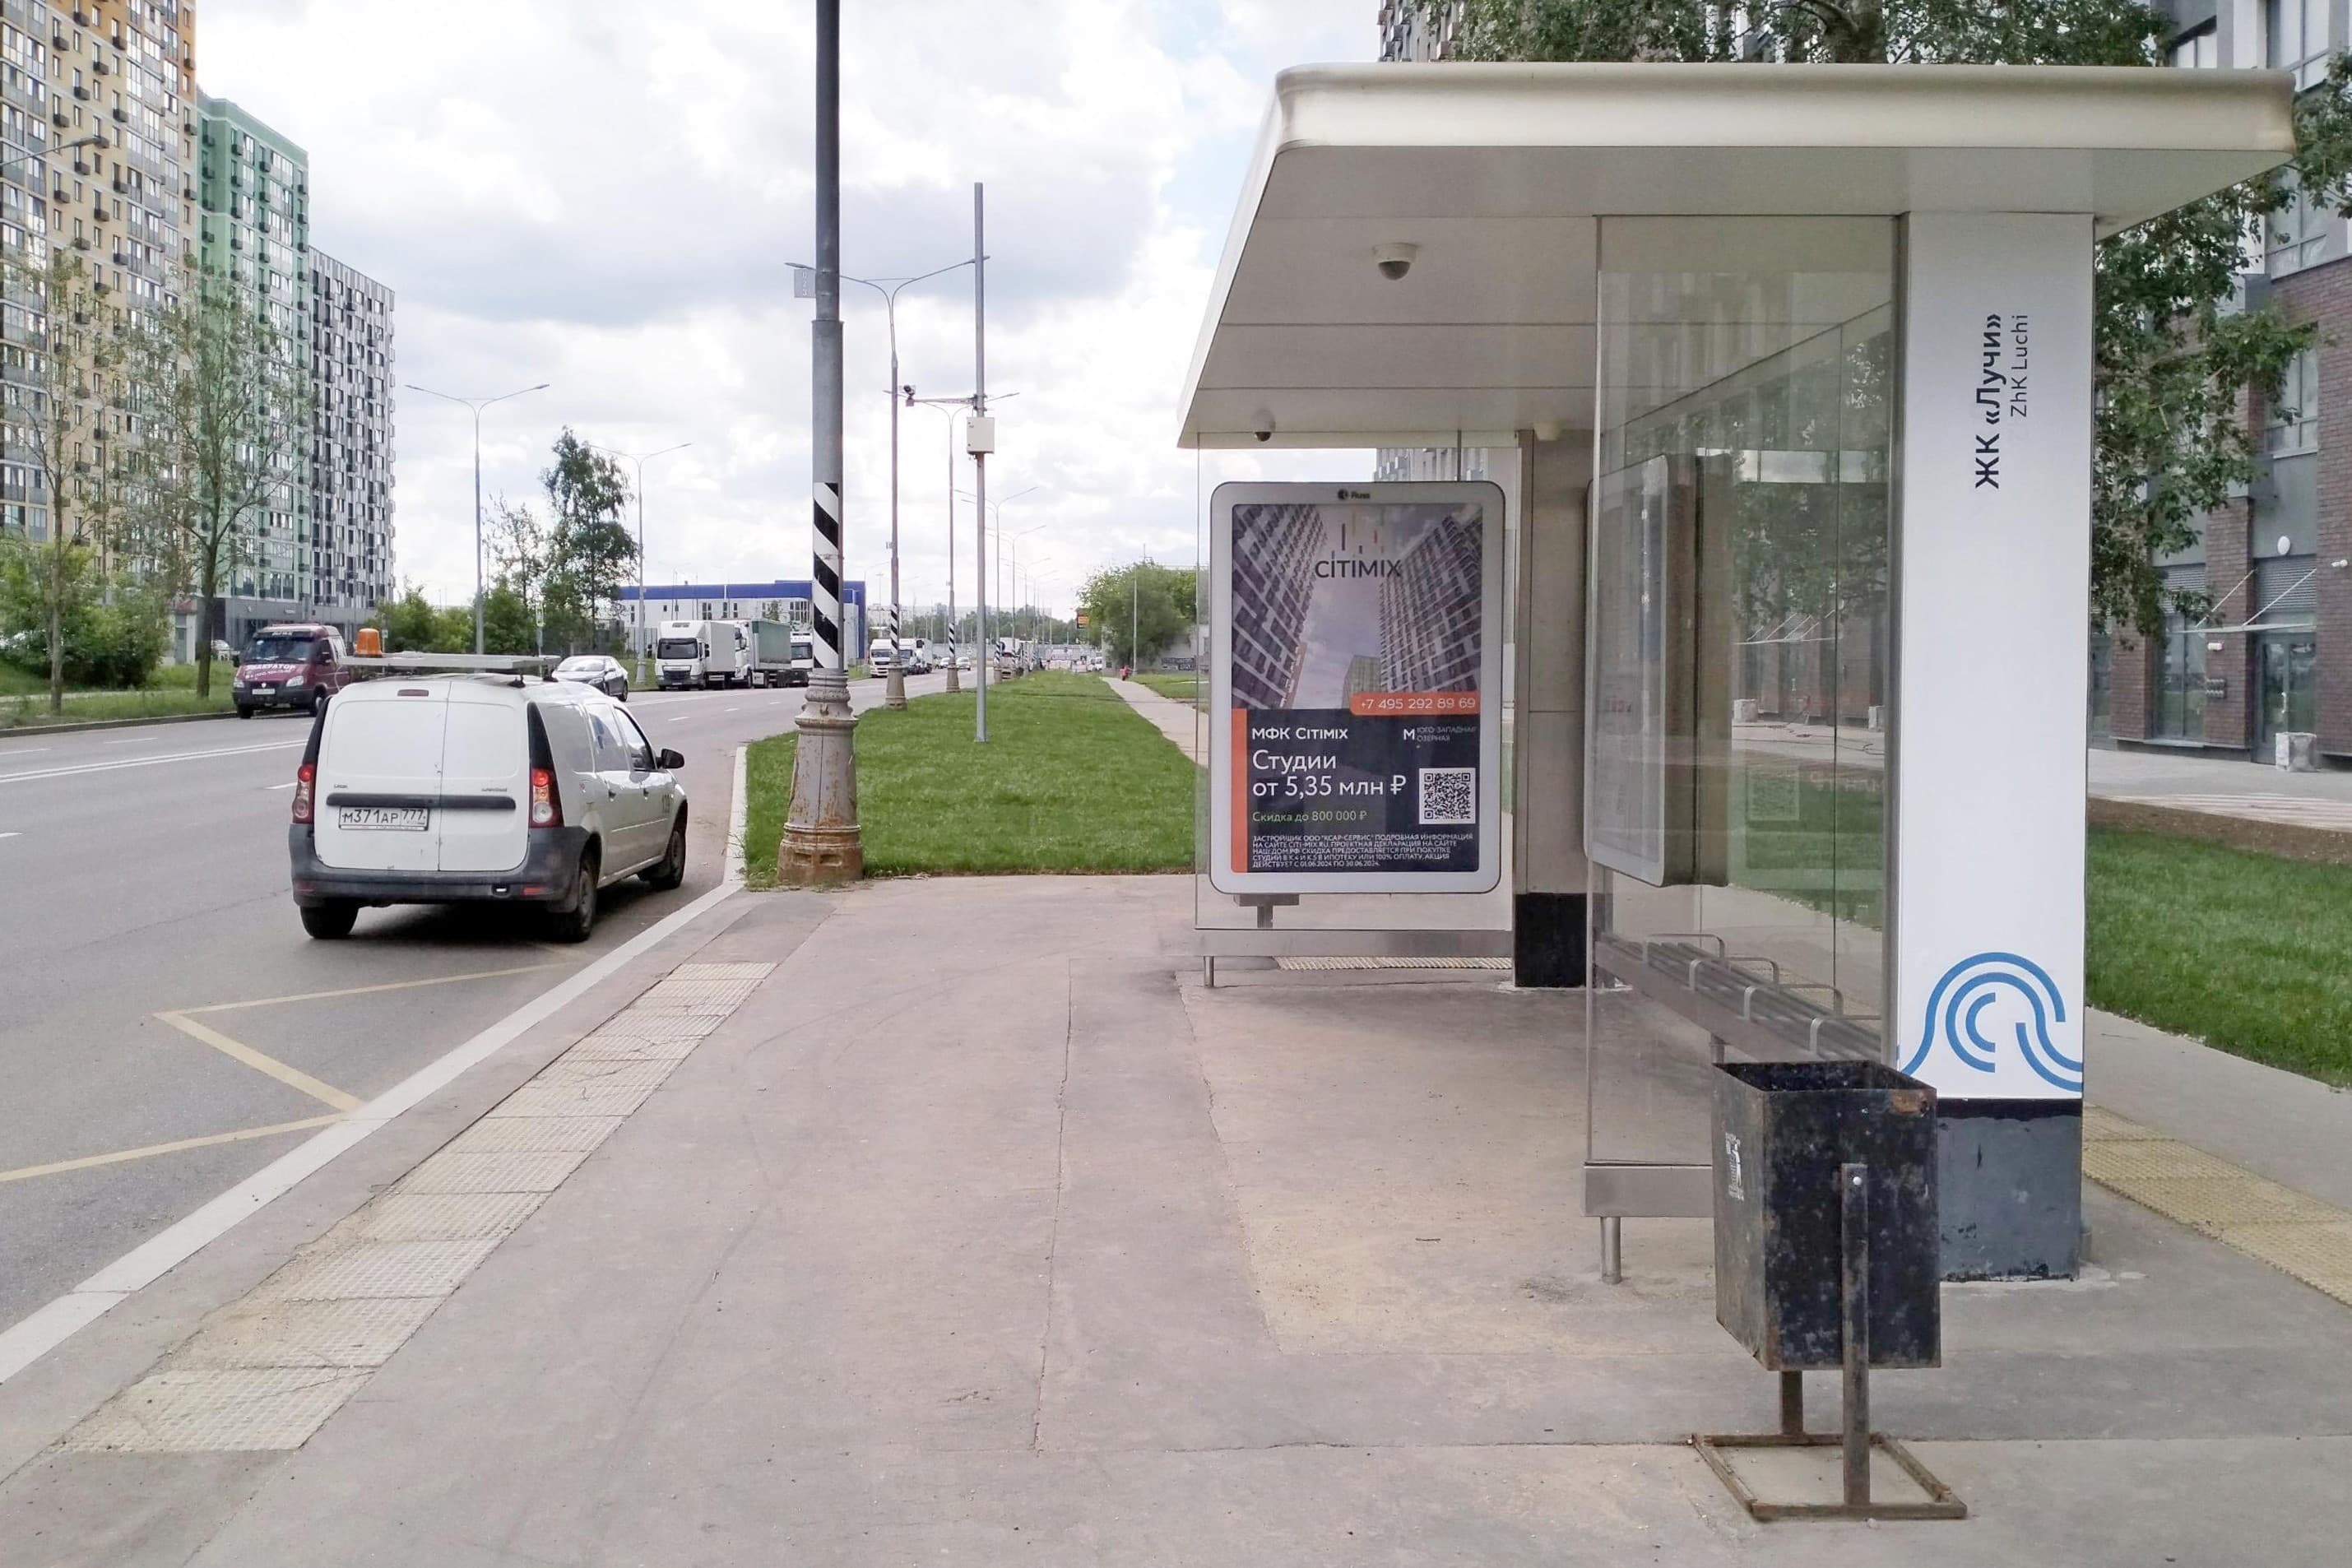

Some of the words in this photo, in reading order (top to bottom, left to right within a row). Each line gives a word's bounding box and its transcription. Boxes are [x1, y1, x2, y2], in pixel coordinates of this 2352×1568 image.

[2011, 315, 2028, 369] Luchi
[1976, 313, 2006, 424] «Лучи»
[2010, 376, 2027, 417] ZhK
[1975, 434, 2000, 489] ЖК
[1315, 559, 1402, 578] CITIMIX
[1361, 699, 1375, 710] +7
[1379, 698, 1403, 709] 495
[1408, 698, 1433, 708] 292
[1437, 698, 1454, 708] 89
[1459, 697, 1476, 708] 69
[1251, 727, 1290, 740] МФК
[1252, 749, 1337, 774] Студии
[1252, 782, 1278, 796] от
[1284, 775, 1332, 800] 5,35
[1338, 782, 1384, 796] млн
[1252, 811, 1292, 823] Скидка
[1295, 814, 1309, 823] до
[1311, 810, 1334, 821] 800
[1336, 810, 1357, 821] 000
